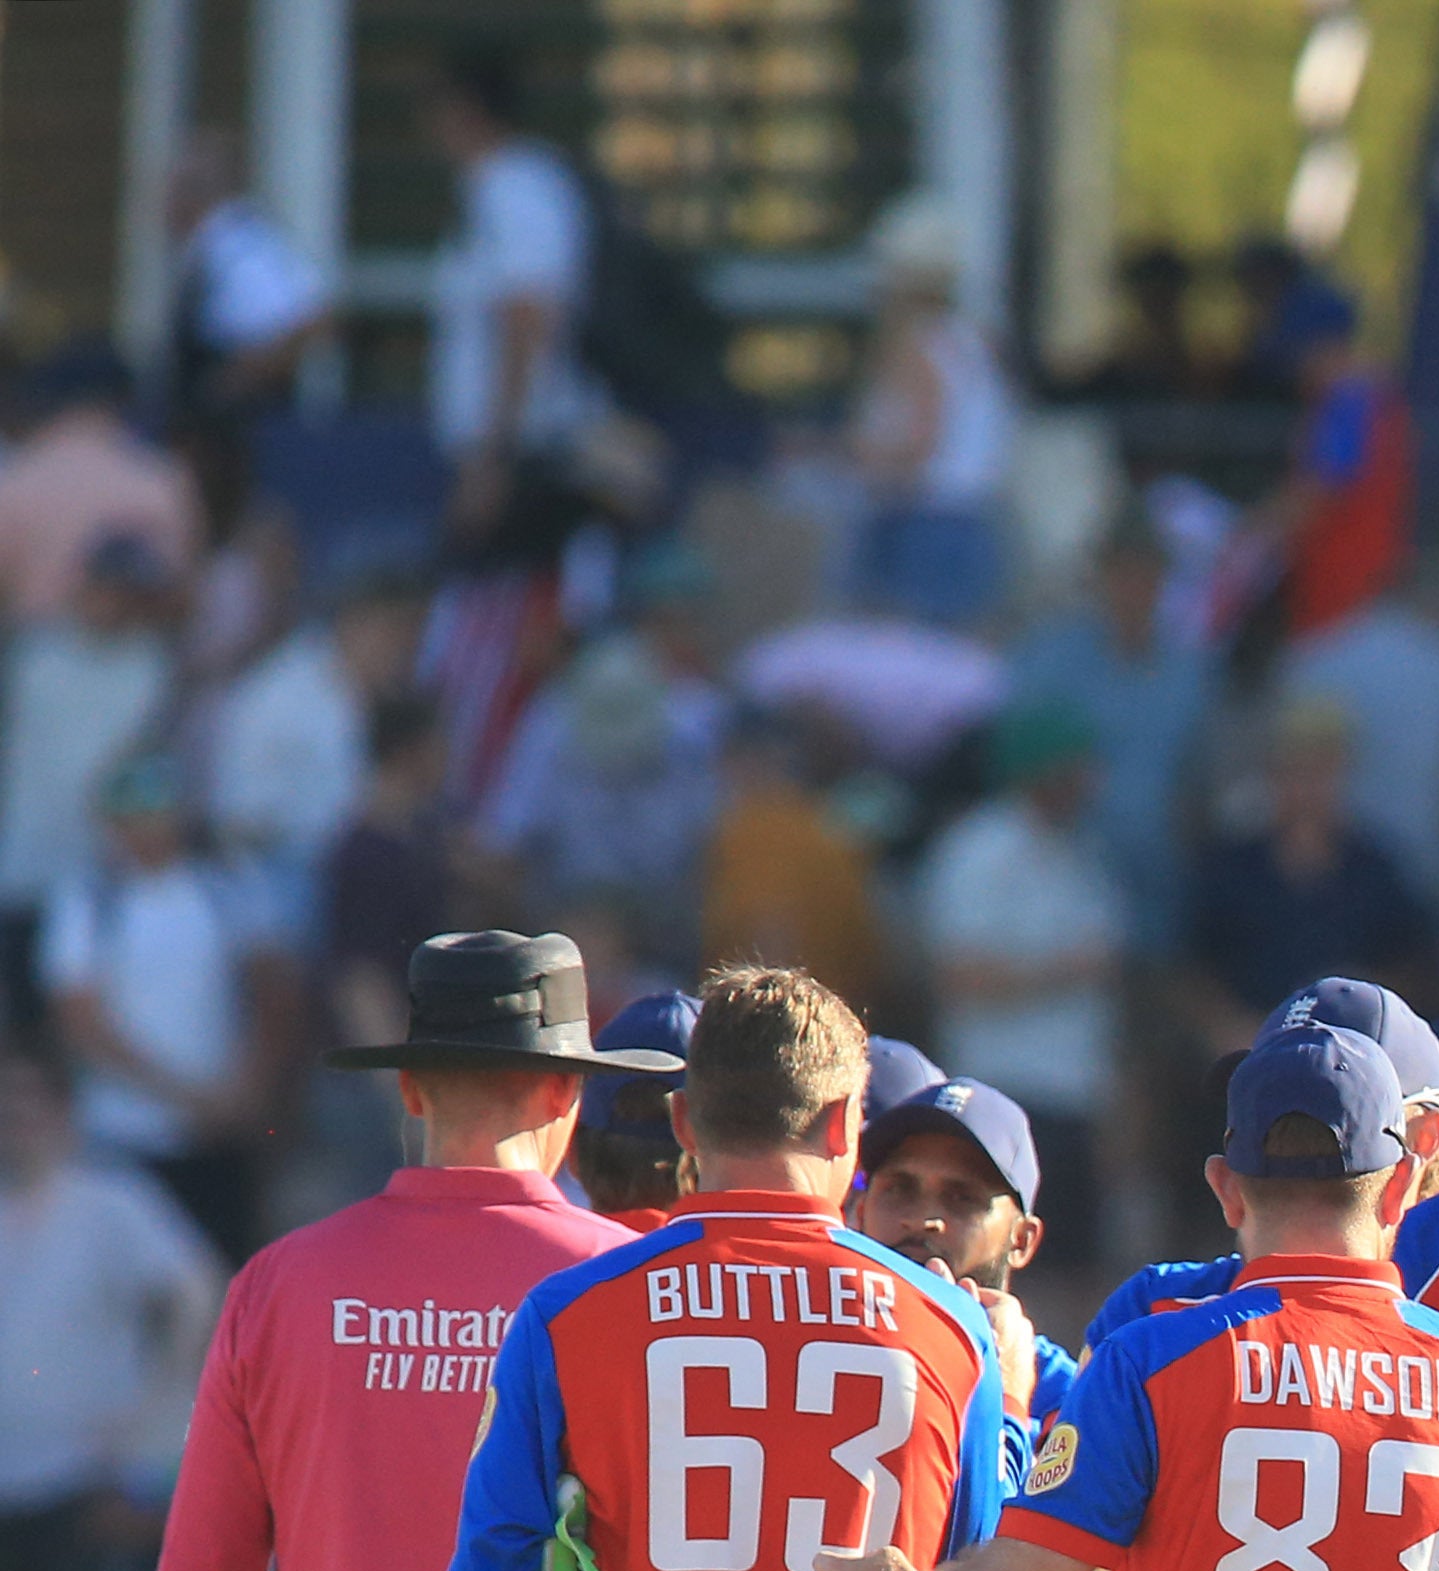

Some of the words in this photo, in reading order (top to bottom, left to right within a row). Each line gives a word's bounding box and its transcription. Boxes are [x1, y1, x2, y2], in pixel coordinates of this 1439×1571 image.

[647, 1262, 899, 1332] BUTTLER
[365, 1352, 415, 1391] FLY
[420, 1353, 498, 1393] BETT
